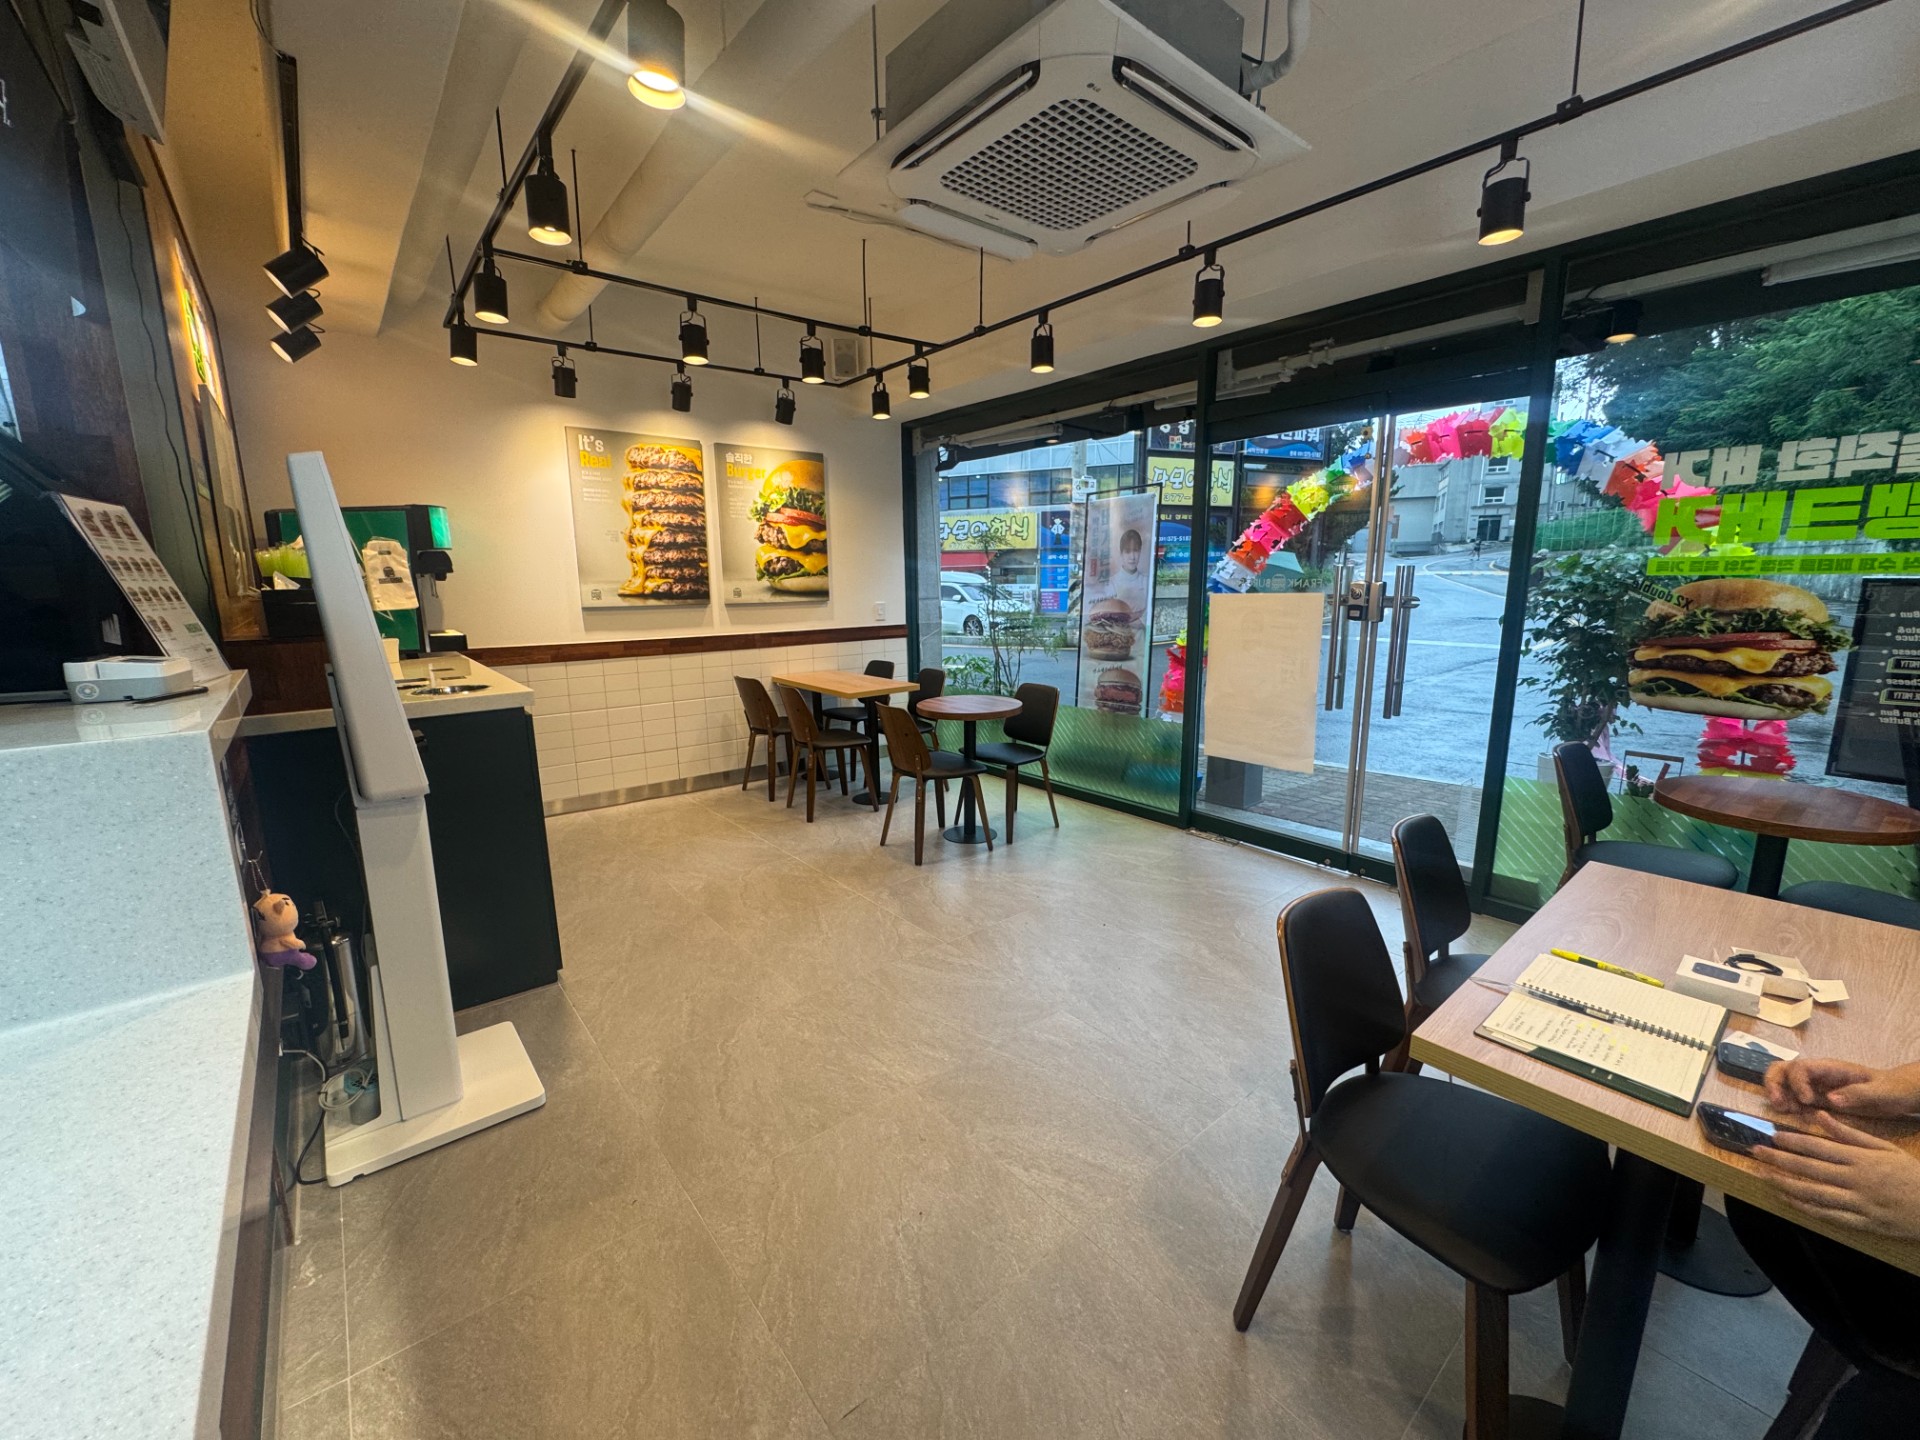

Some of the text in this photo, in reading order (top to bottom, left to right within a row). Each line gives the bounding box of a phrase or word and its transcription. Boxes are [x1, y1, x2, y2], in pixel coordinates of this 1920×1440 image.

[579, 451, 612, 469] Real
[725, 452, 753, 464] 솔직한
[726, 463, 767, 481] Burger
